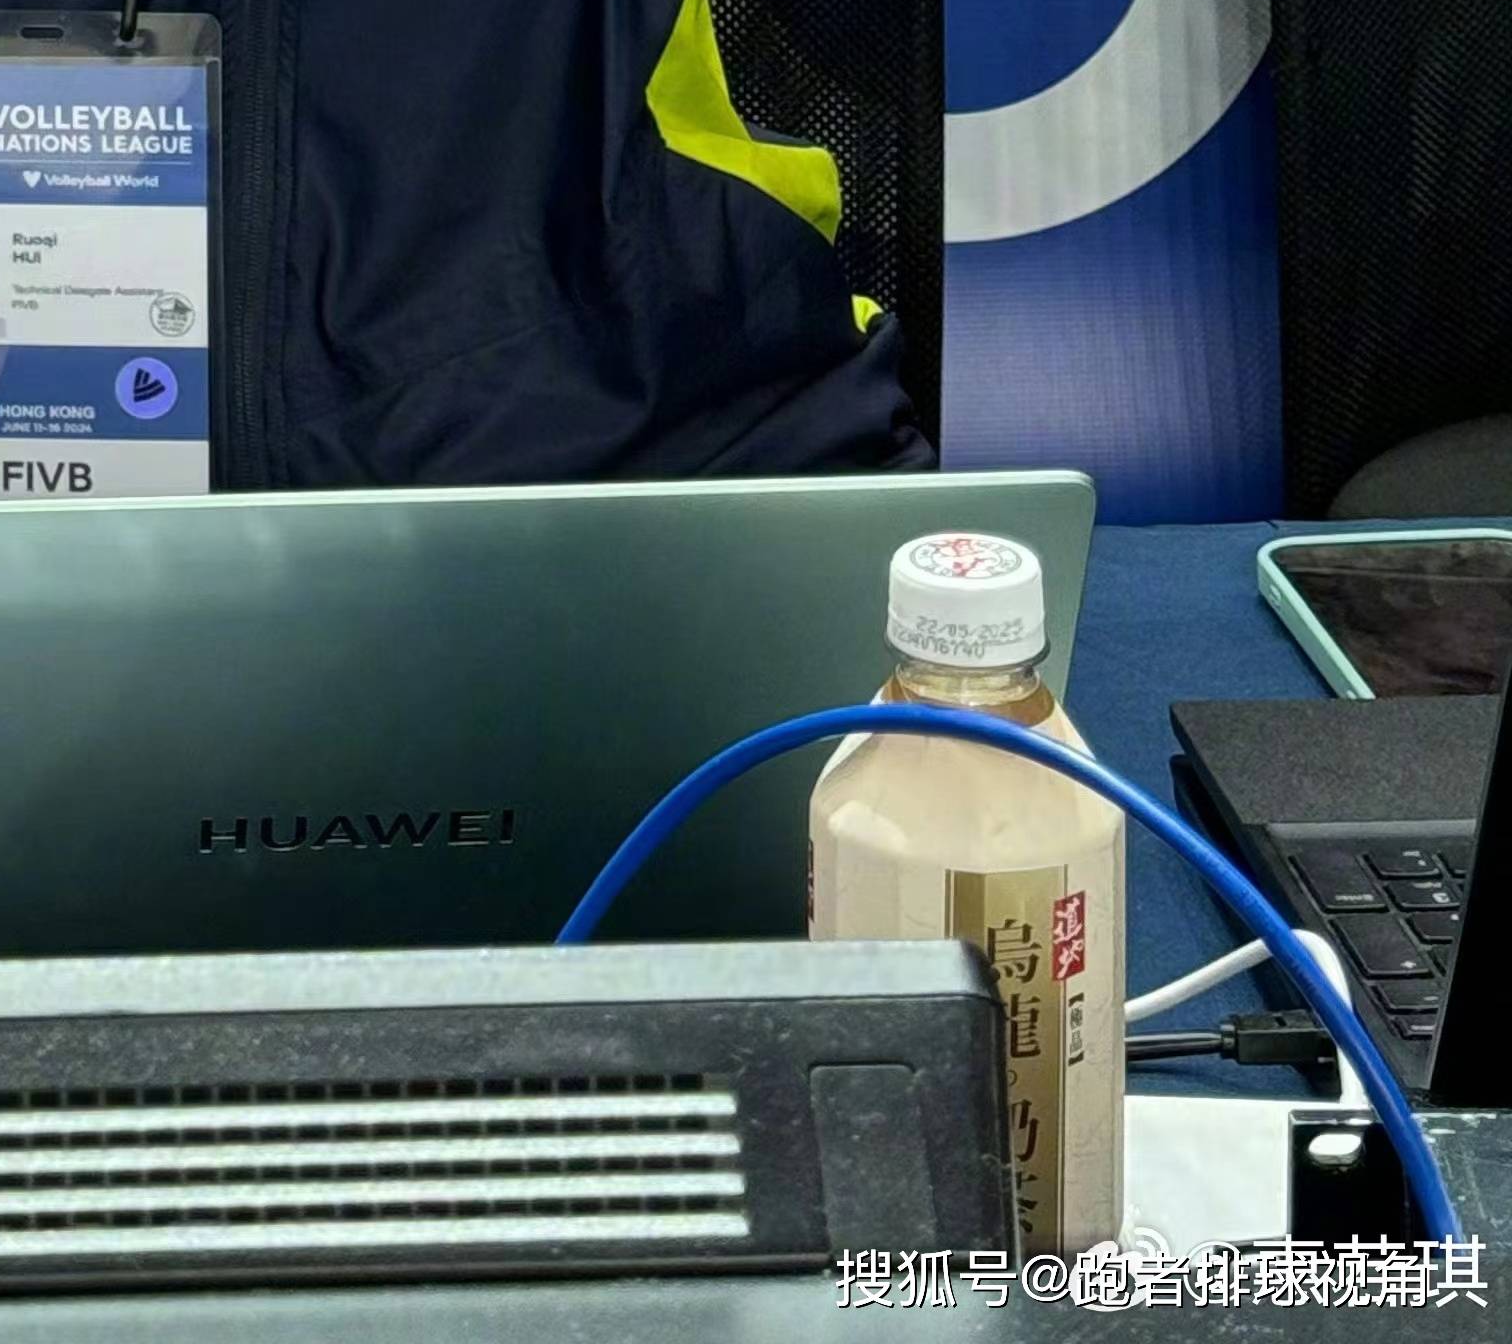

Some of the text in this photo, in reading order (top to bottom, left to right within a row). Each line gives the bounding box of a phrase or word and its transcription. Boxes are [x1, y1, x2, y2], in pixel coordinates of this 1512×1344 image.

[100, 135, 193, 155] LEAGUE
[44, 172, 159, 190] Volleyball World
[12, 232, 58, 250] Ruoqi
[12, 250, 42, 265] HUI
[0, 404, 96, 420] HONG KONG
[1, 422, 31, 433] JUNE
[2, 461, 94, 494] FIVB
[198, 810, 516, 854] HUAWEI
